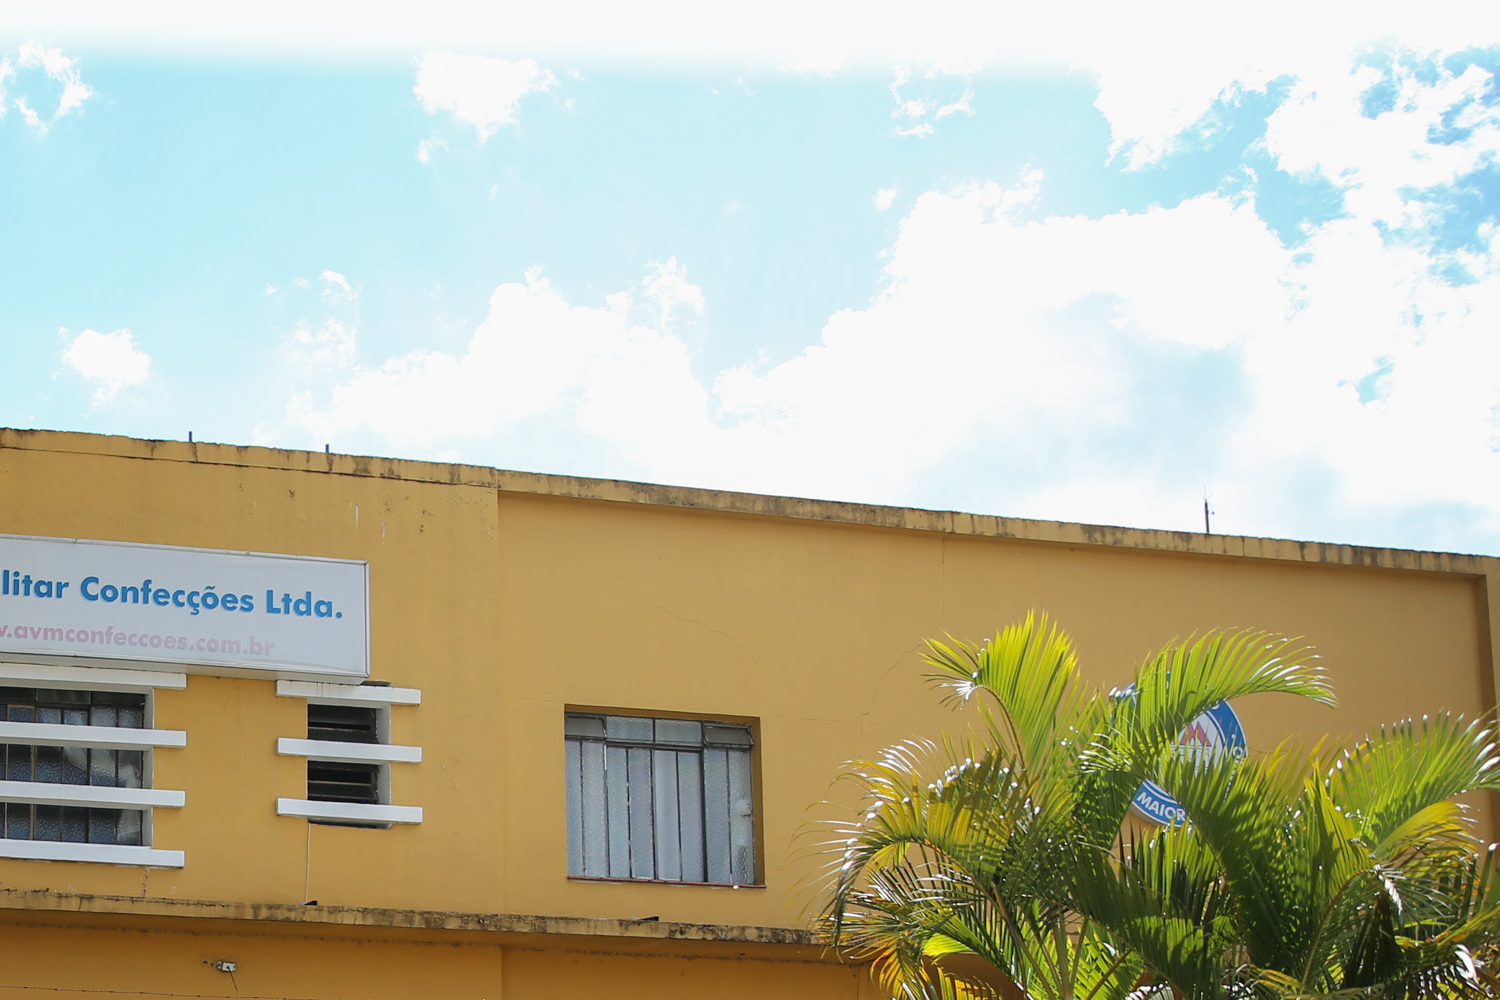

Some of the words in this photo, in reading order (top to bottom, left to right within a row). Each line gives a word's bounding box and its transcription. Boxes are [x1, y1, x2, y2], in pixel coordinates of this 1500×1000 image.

[80, 576, 255, 615] Confecções
[266, 589, 344, 620] Ltda.
[1136, 791, 1188, 822] MAIOR
